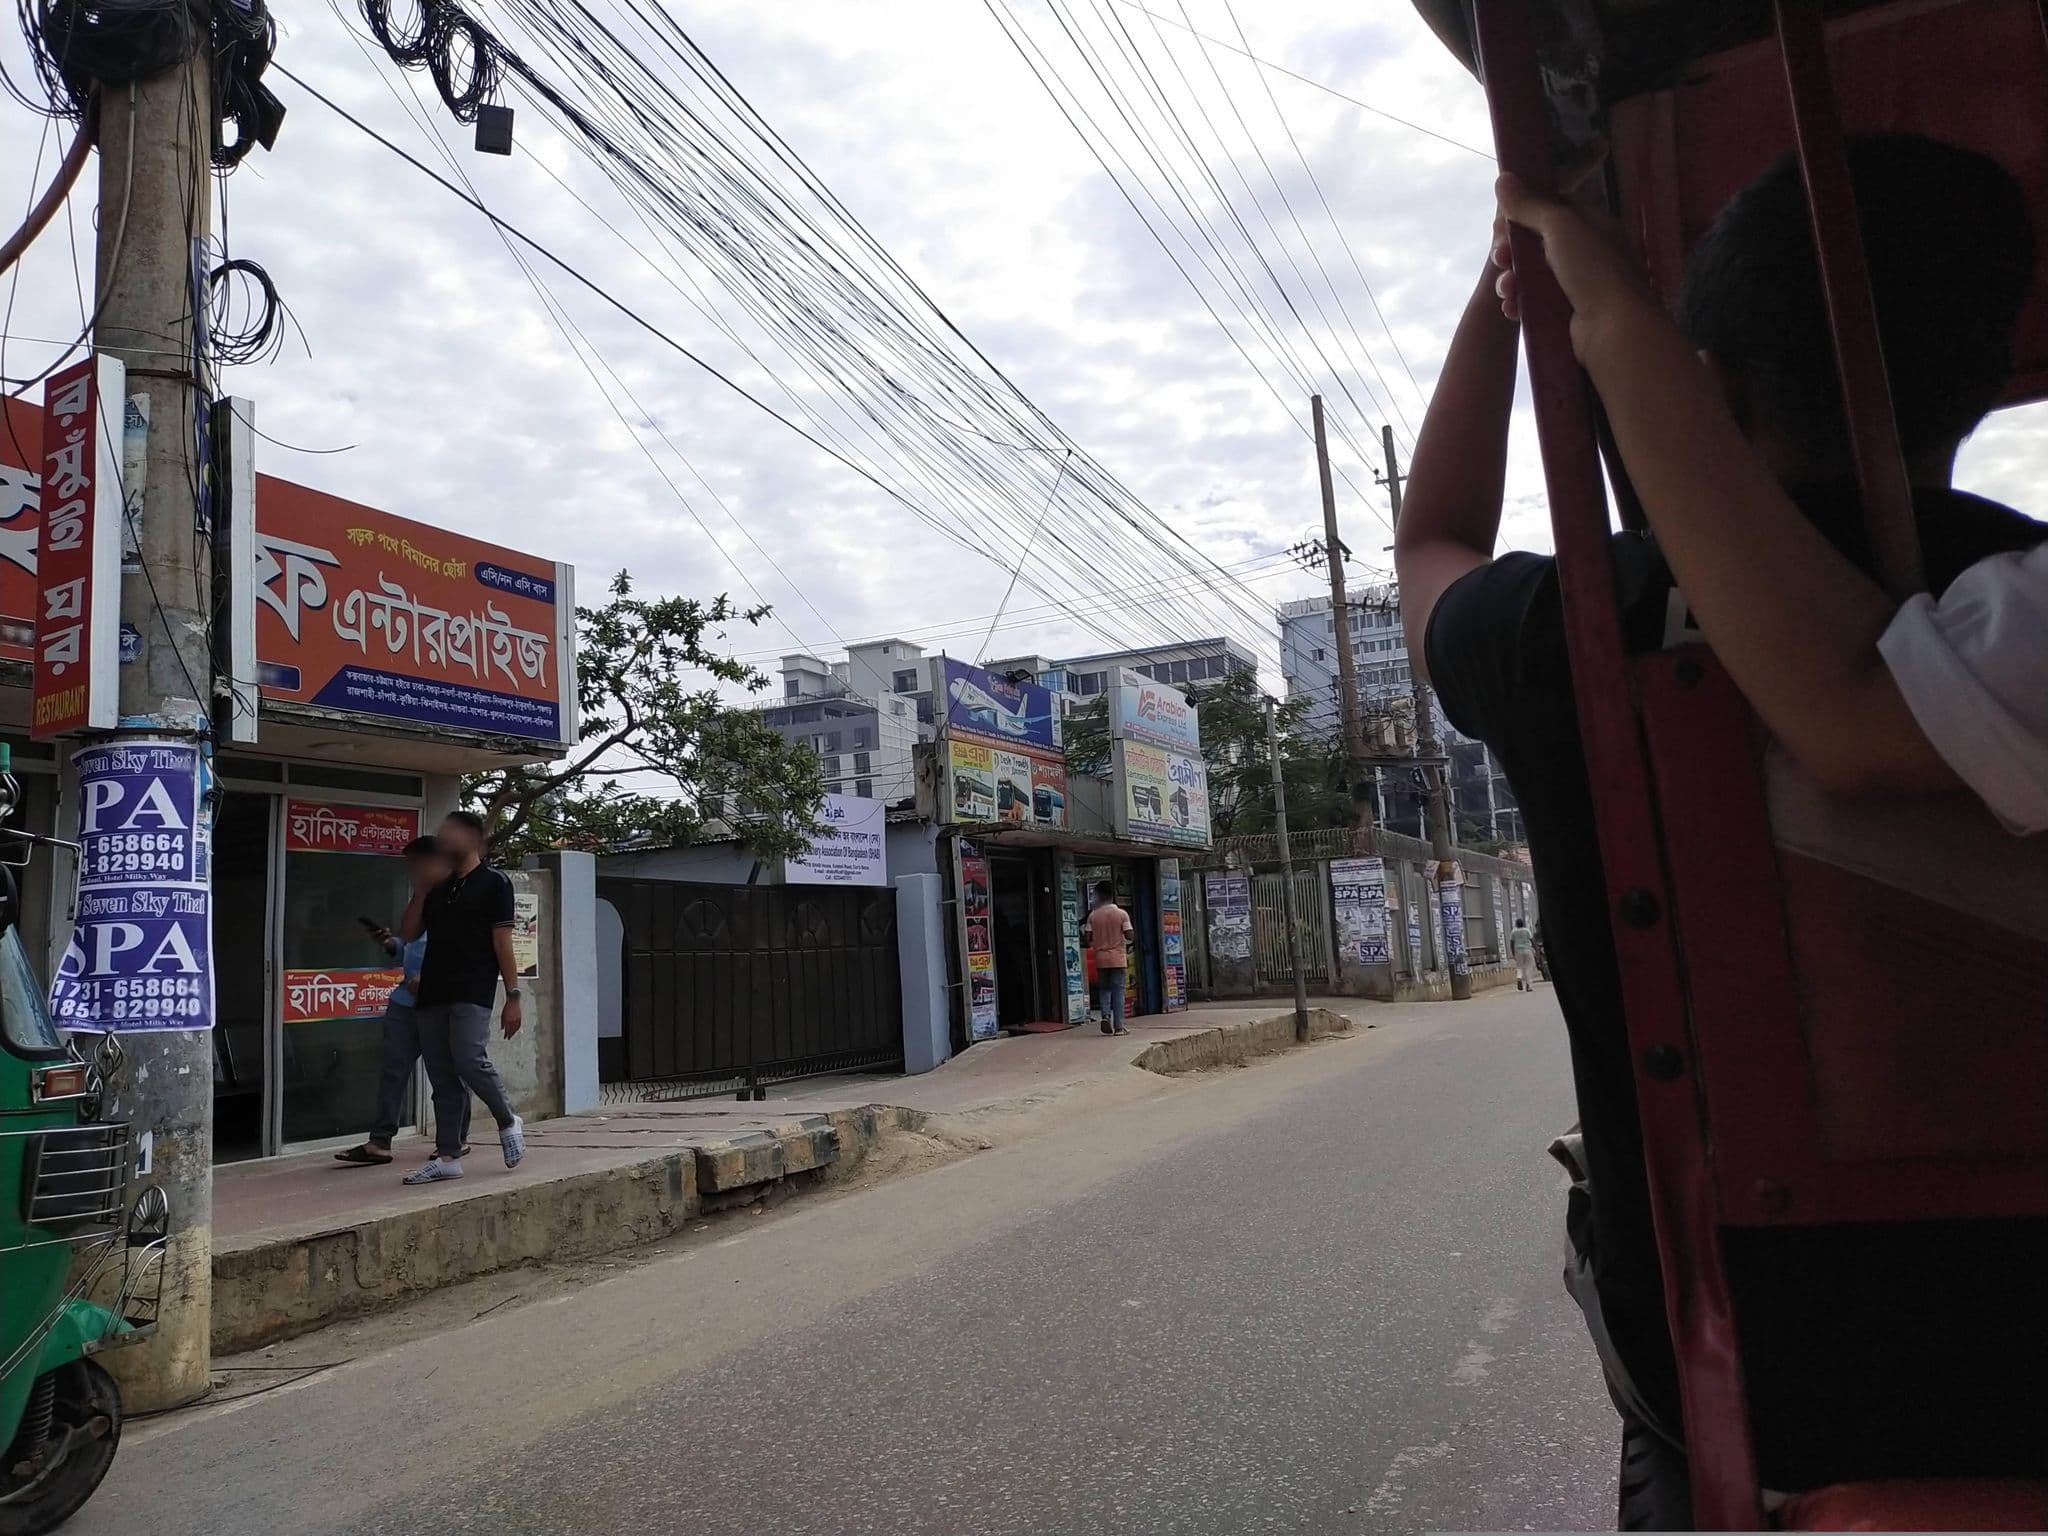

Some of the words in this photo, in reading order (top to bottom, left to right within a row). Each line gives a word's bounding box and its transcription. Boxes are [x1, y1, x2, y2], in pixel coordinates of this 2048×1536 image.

[346, 528, 376, 546] সড়ক
[378, 533, 400, 554] পথে
[400, 539, 440, 575] বিমানের
[515, 577, 531, 593] এসি
[532, 583, 548, 598] বাস
[333, 571, 550, 691] এন্টারপ্রাইজ
[36, 685, 86, 727] RESTAURANT
[1157, 696, 1187, 718] Arabian
[112, 750, 148, 773] Sky
[290, 808, 360, 846] হানিফ
[360, 823, 411, 842] এন্টারপ্রাইজ
[822, 845, 842, 857] Association
[848, 846, 867, 861] Bangladesh
[82, 894, 128, 916] Seven
[132, 891, 170, 917] Sky
[172, 891, 205, 914] Thai
[1334, 890, 1359, 899] SPA
[1360, 890, 1384, 899] SPA
[1361, 946, 1387, 956] SPA
[287, 974, 358, 1016] হানিফ
